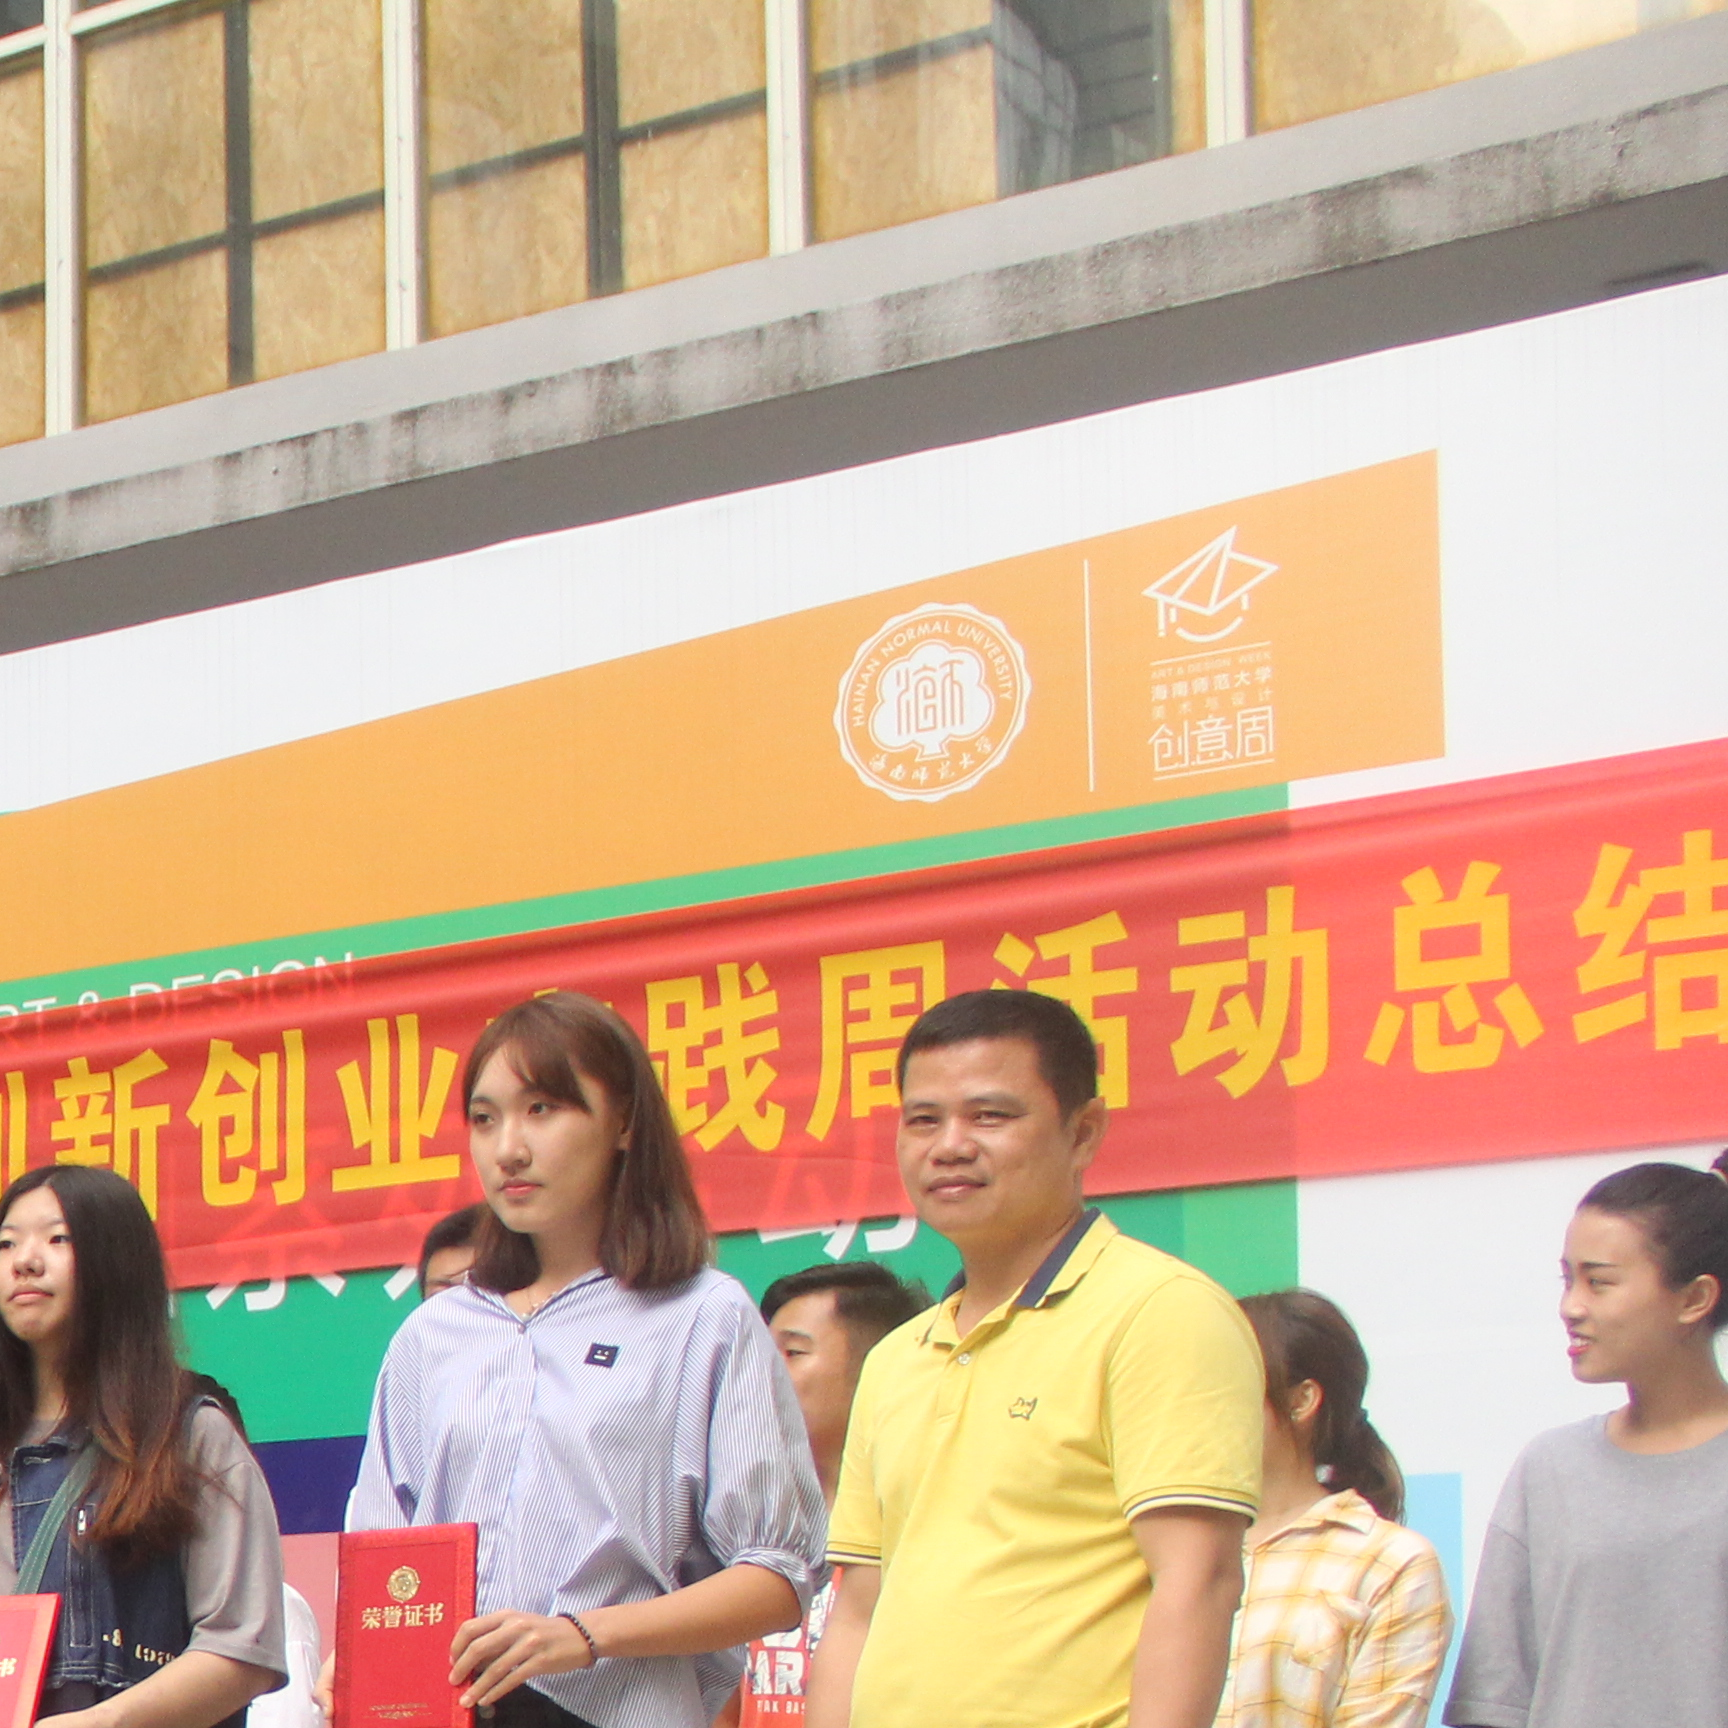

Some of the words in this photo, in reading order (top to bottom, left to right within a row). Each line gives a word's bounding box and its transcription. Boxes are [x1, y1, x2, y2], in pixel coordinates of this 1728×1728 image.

[851, 659, 881, 728] HAINAN
[880, 620, 951, 658] NORMAL
[956, 623, 1013, 700] UNIVERSITY
[1147, 704, 1274, 773] 创意周
[361, 1602, 445, 1630] 荣誉证书
